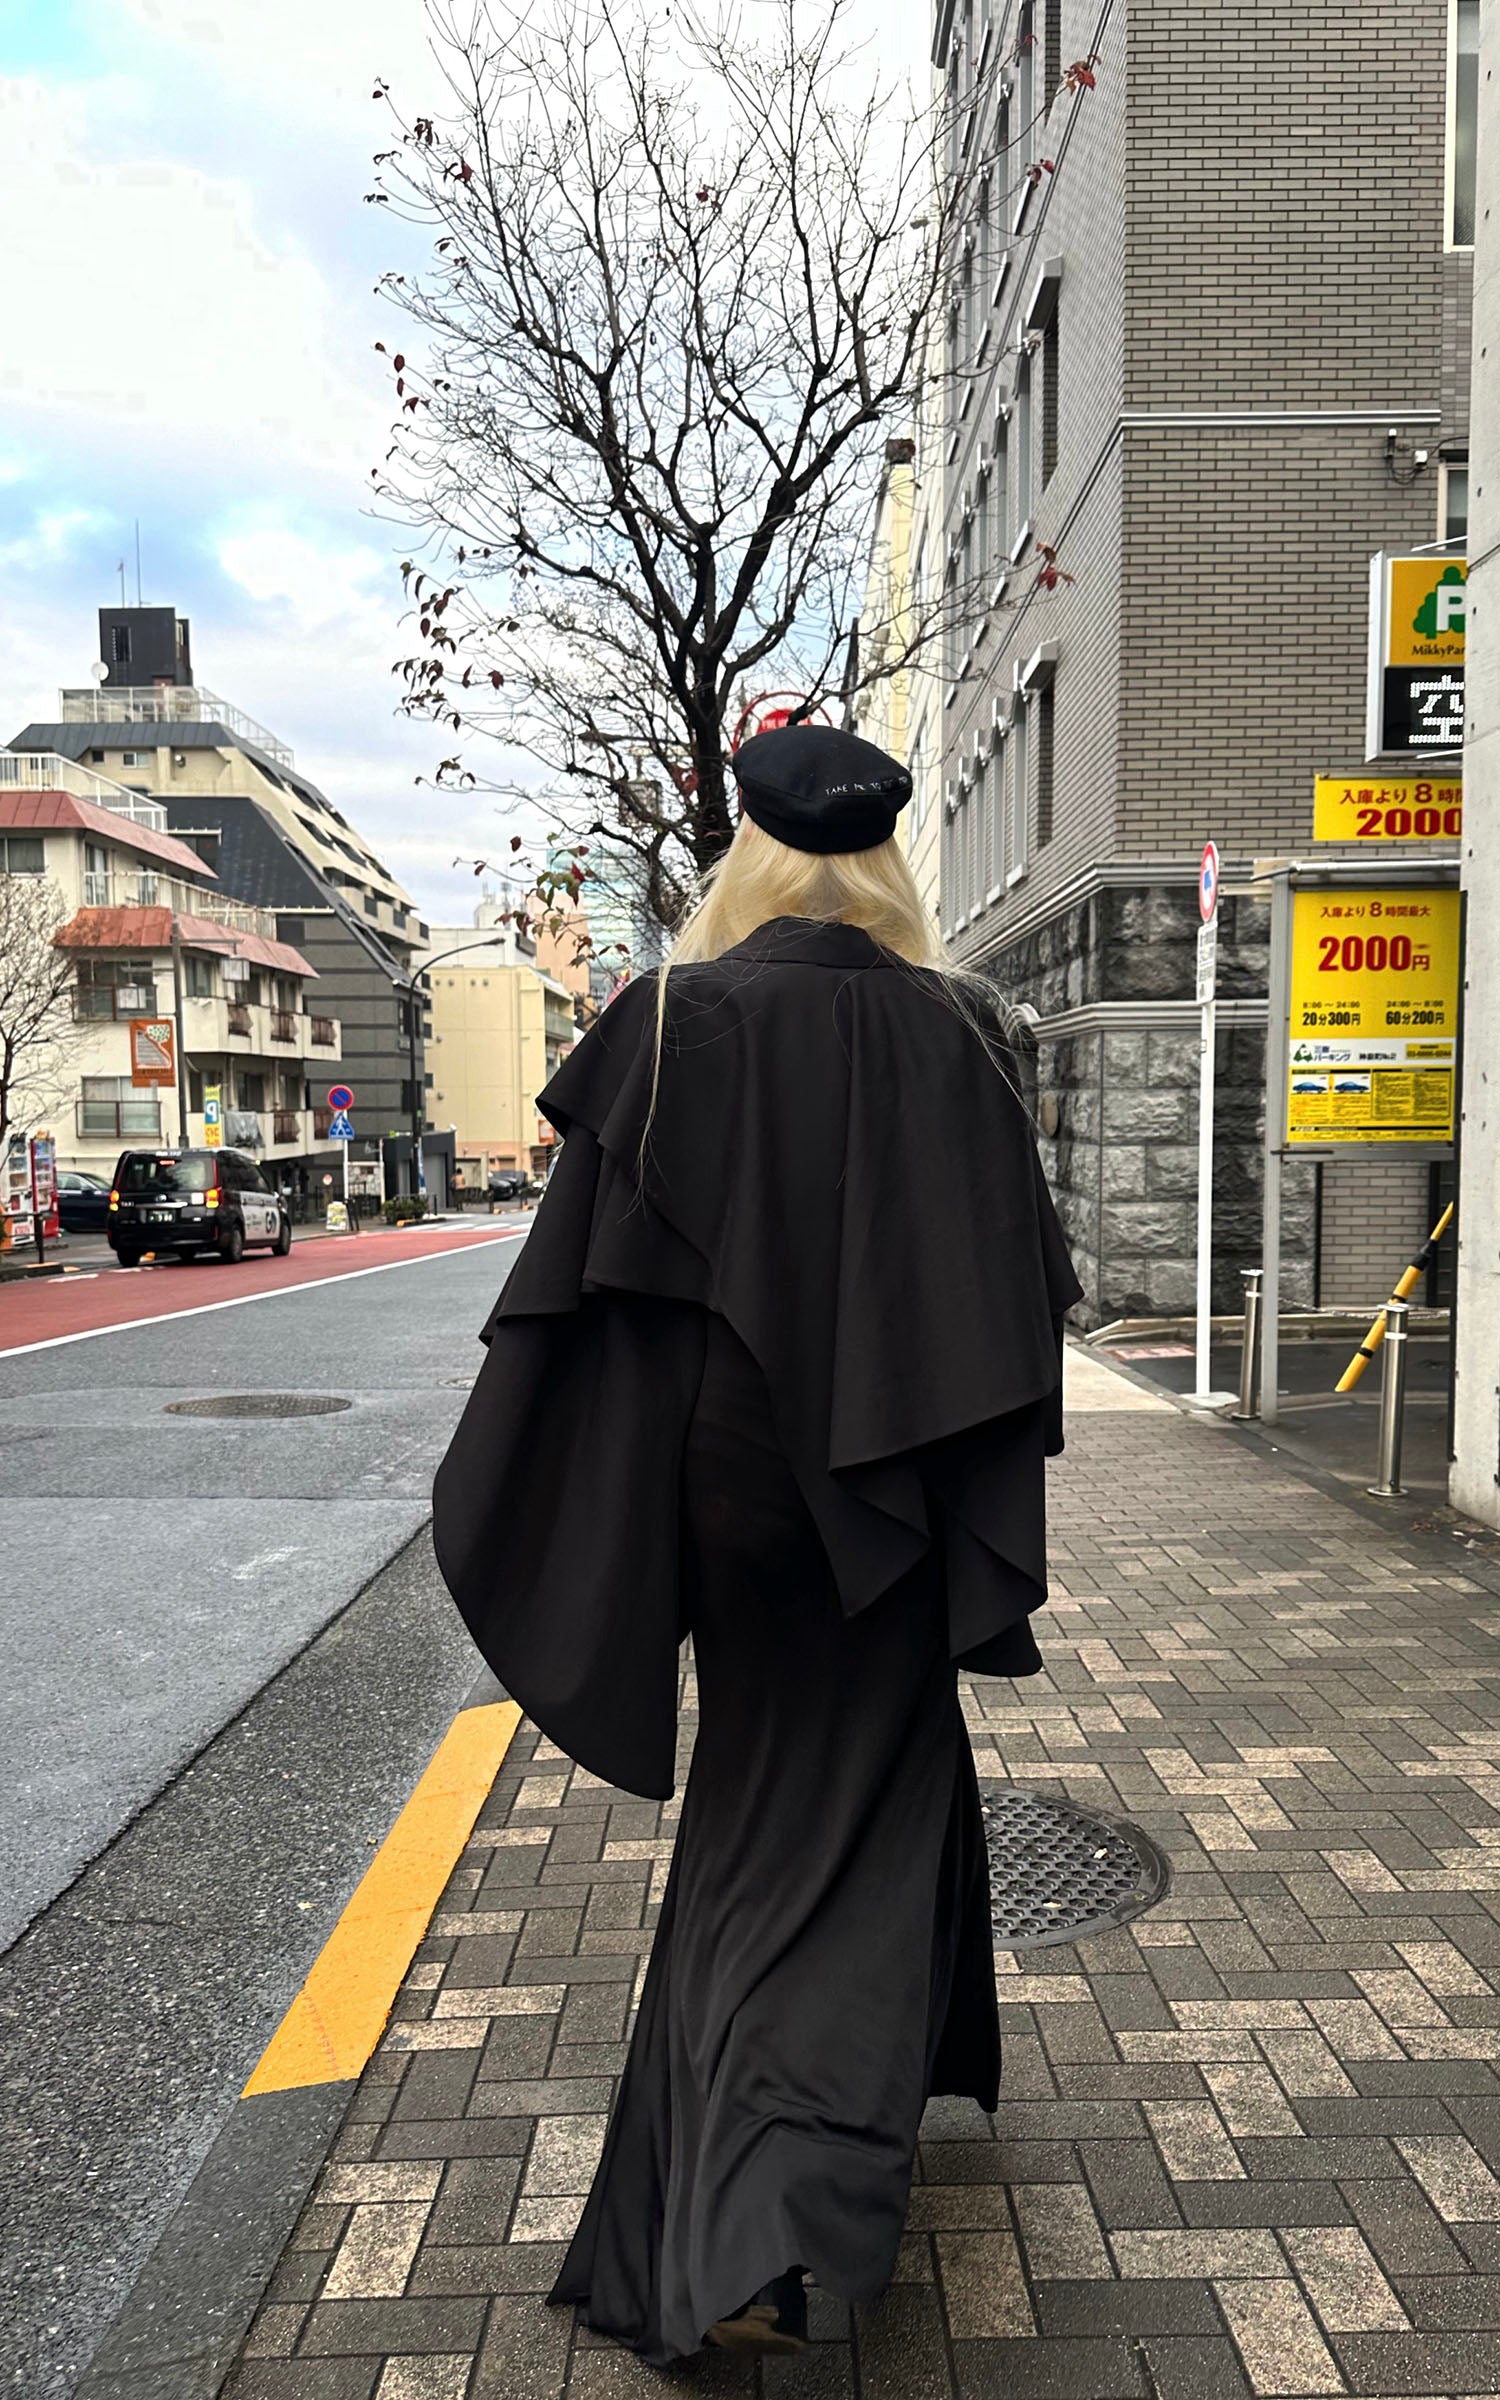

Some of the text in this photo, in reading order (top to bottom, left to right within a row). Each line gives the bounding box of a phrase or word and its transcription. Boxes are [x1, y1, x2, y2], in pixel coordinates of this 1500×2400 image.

[1437, 585, 1466, 632] P
[1409, 675, 1464, 744] 空
[825, 783, 848, 796] TAKE
[1356, 808, 1463, 836] 2000
